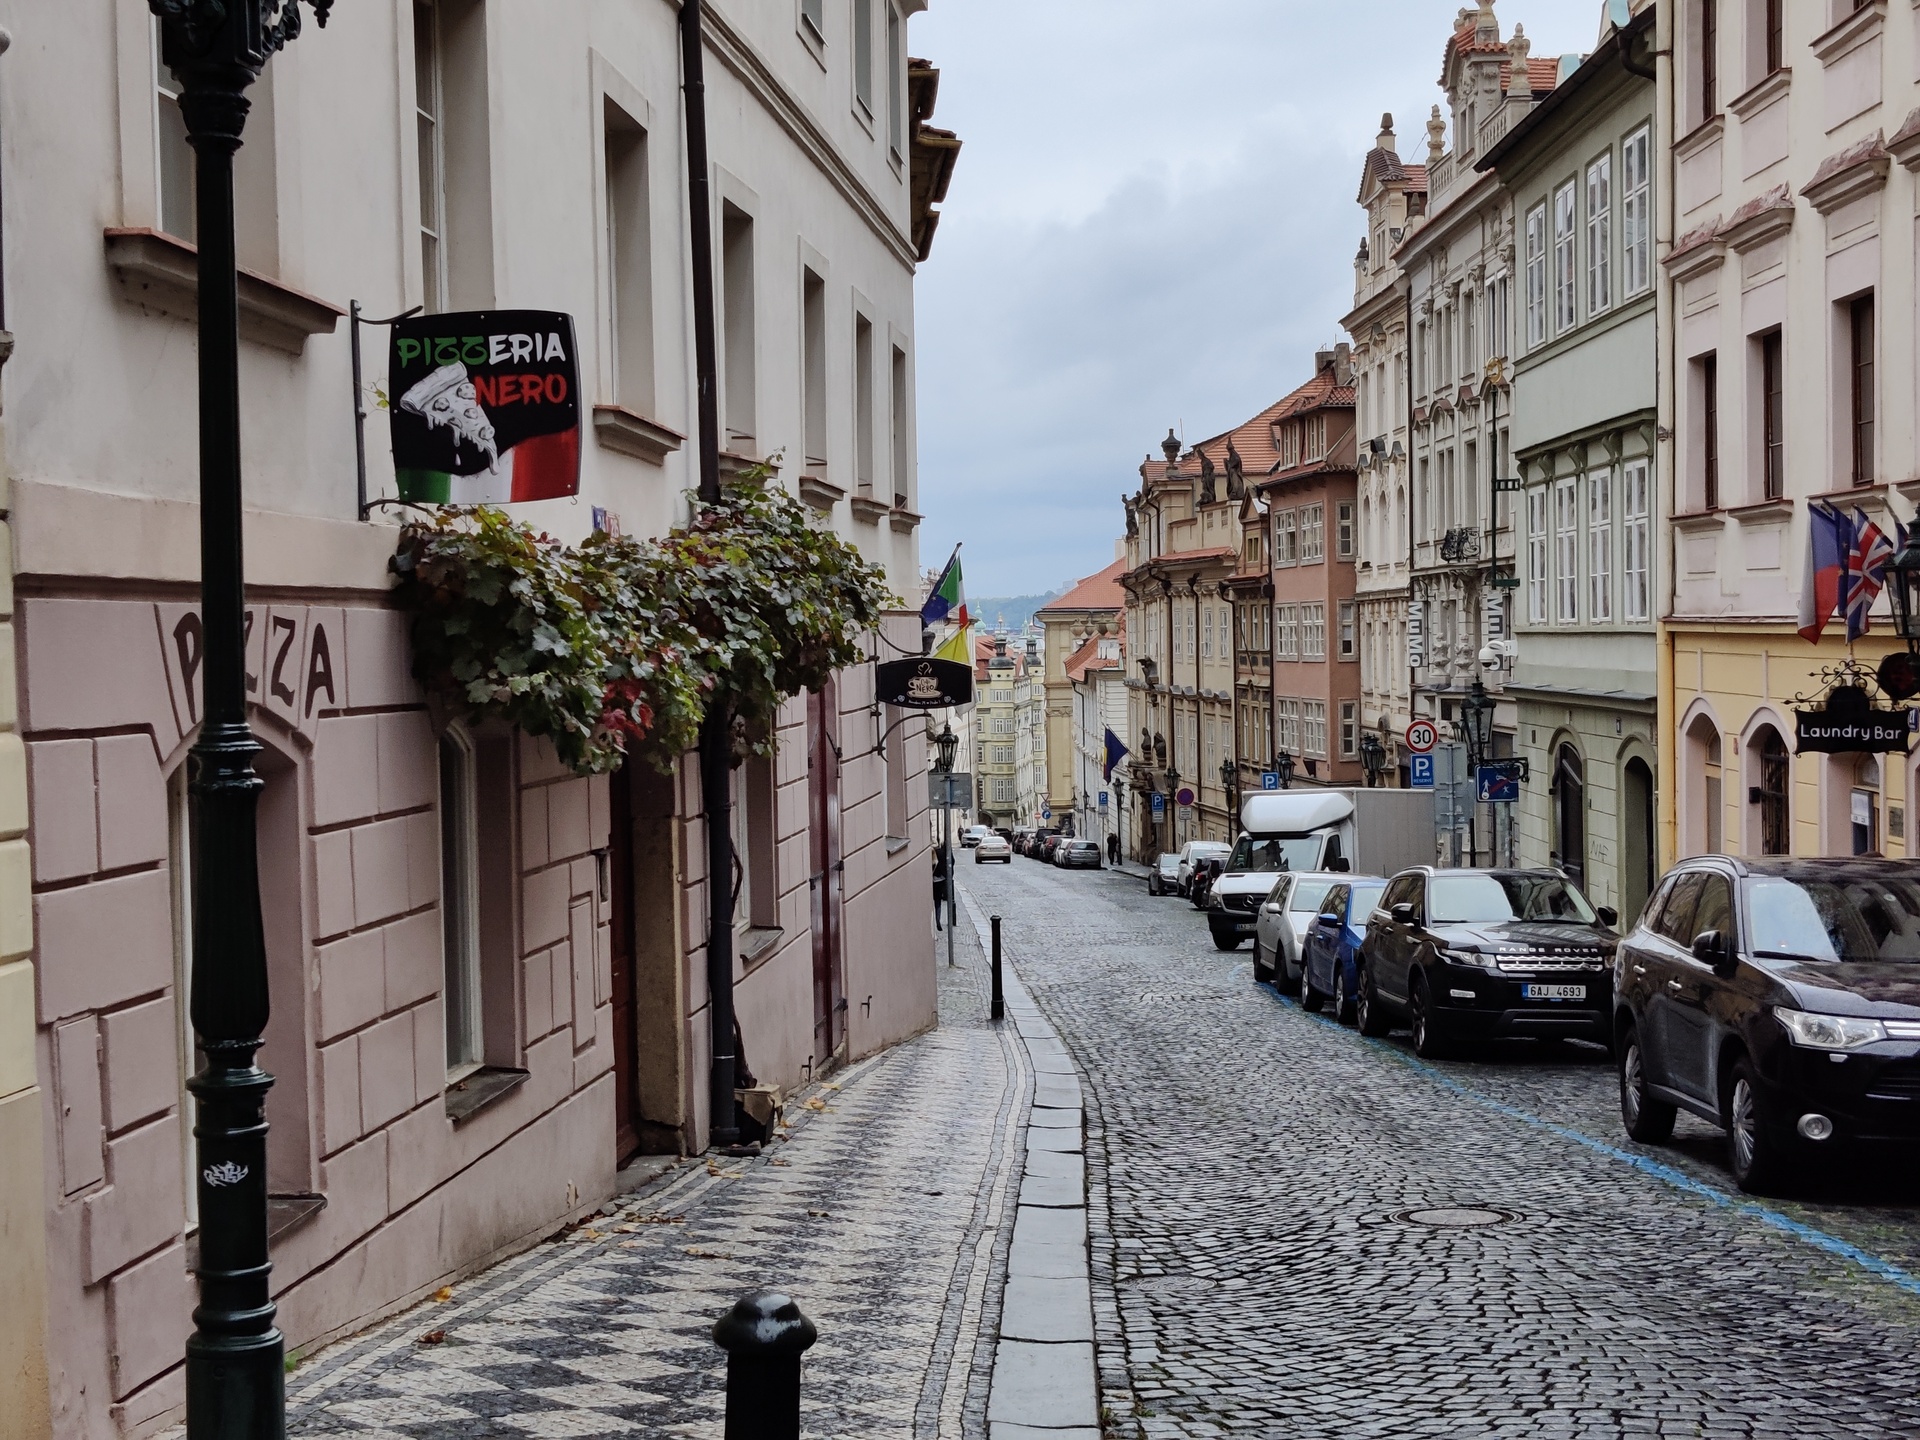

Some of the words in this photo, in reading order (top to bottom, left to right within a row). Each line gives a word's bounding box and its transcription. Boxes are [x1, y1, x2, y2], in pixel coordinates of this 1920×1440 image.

[397, 332, 566, 368] PIZZERIA
[474, 374, 568, 407] NERO
[1412, 729, 1432, 744] 30
[1800, 724, 1870, 741] Laundry
[1874, 725, 1902, 740] Bar
[1415, 758, 1429, 777] P
[1265, 775, 1275, 789] P
[1154, 795, 1162, 806] P
[1530, 985, 1550, 997] 6AJ
[1556, 986, 1581, 997] 4693
